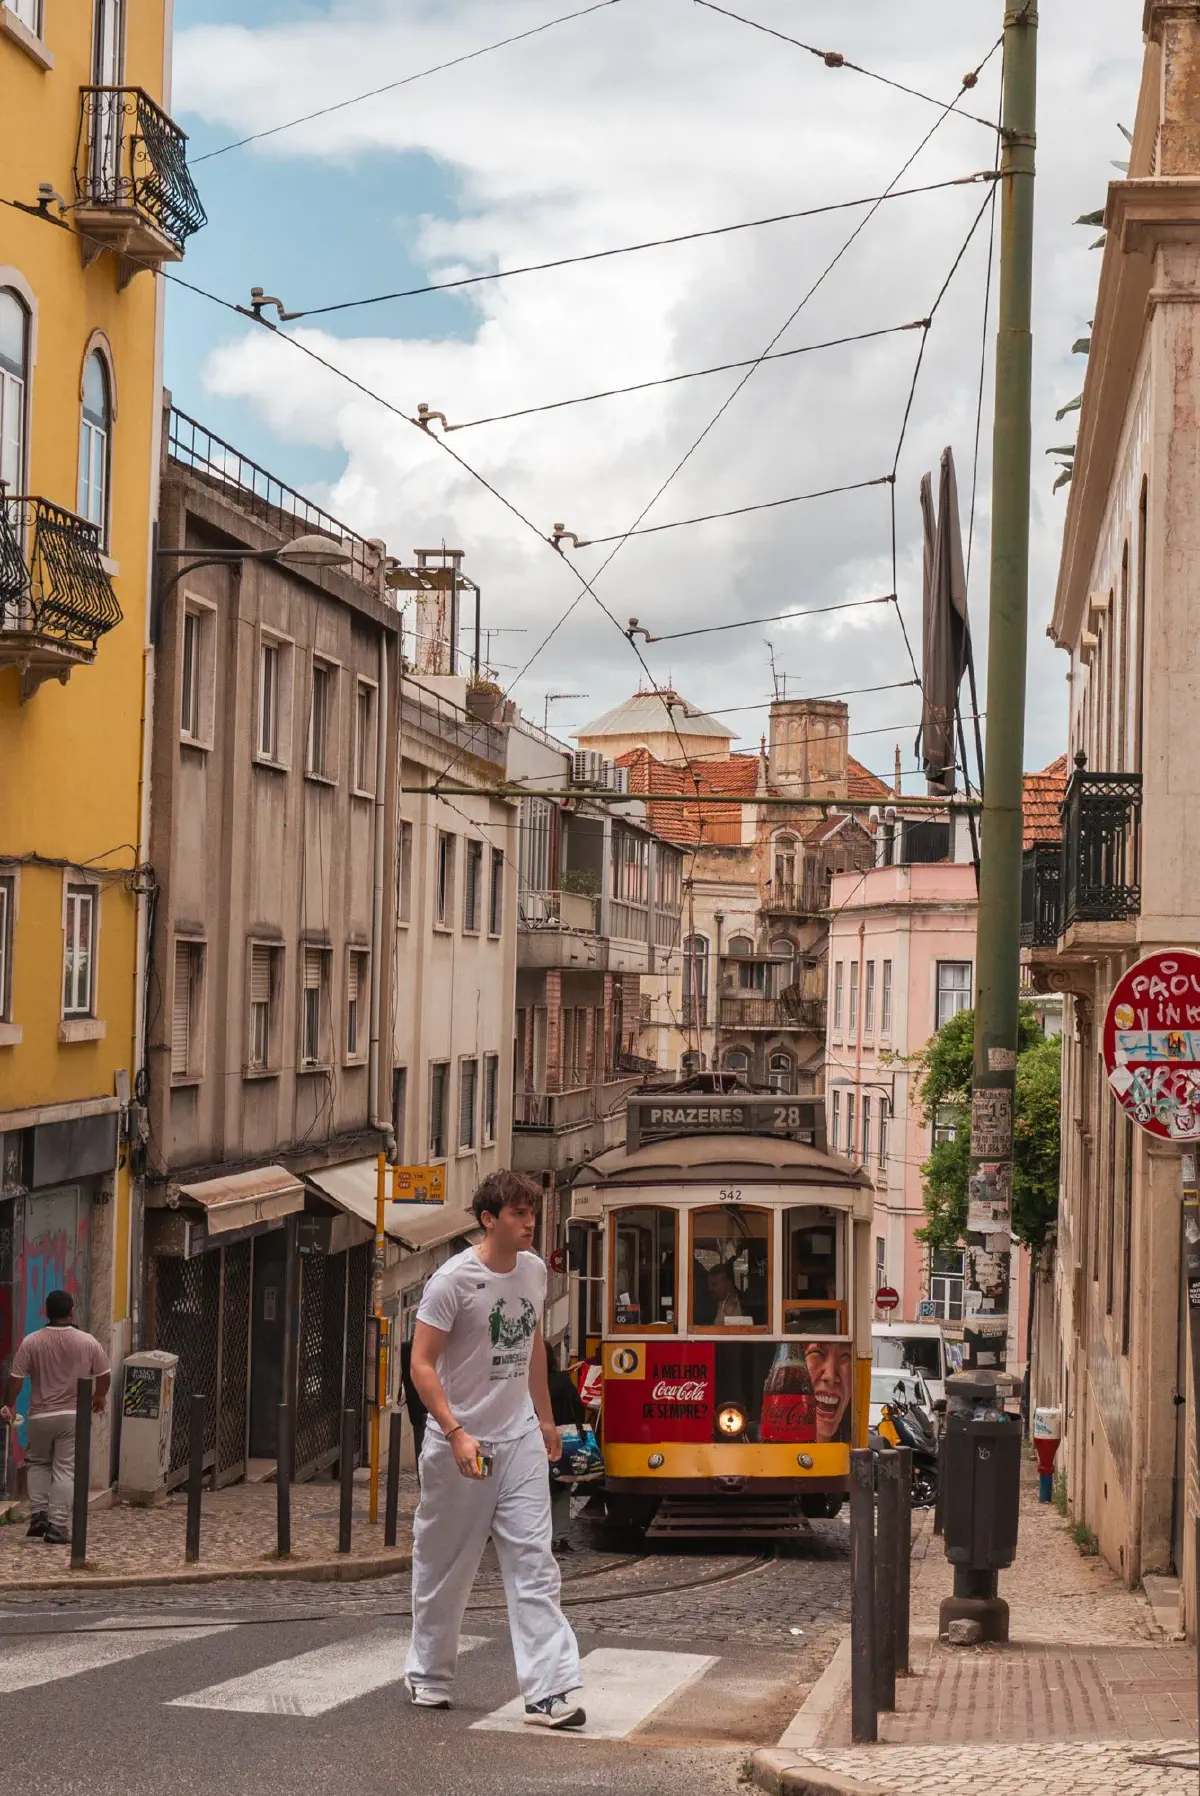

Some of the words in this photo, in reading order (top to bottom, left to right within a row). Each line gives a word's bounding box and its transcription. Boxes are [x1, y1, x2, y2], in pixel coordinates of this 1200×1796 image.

[651, 1108, 744, 1123] PRAZERES
[773, 1106, 800, 1128] 28
[719, 1190, 742, 1200] 542
[652, 1364, 659, 1379] A
[661, 1364, 708, 1379] MELHOR
[643, 1404, 656, 1419] DE
[657, 1404, 708, 1419] SEMPRE?
